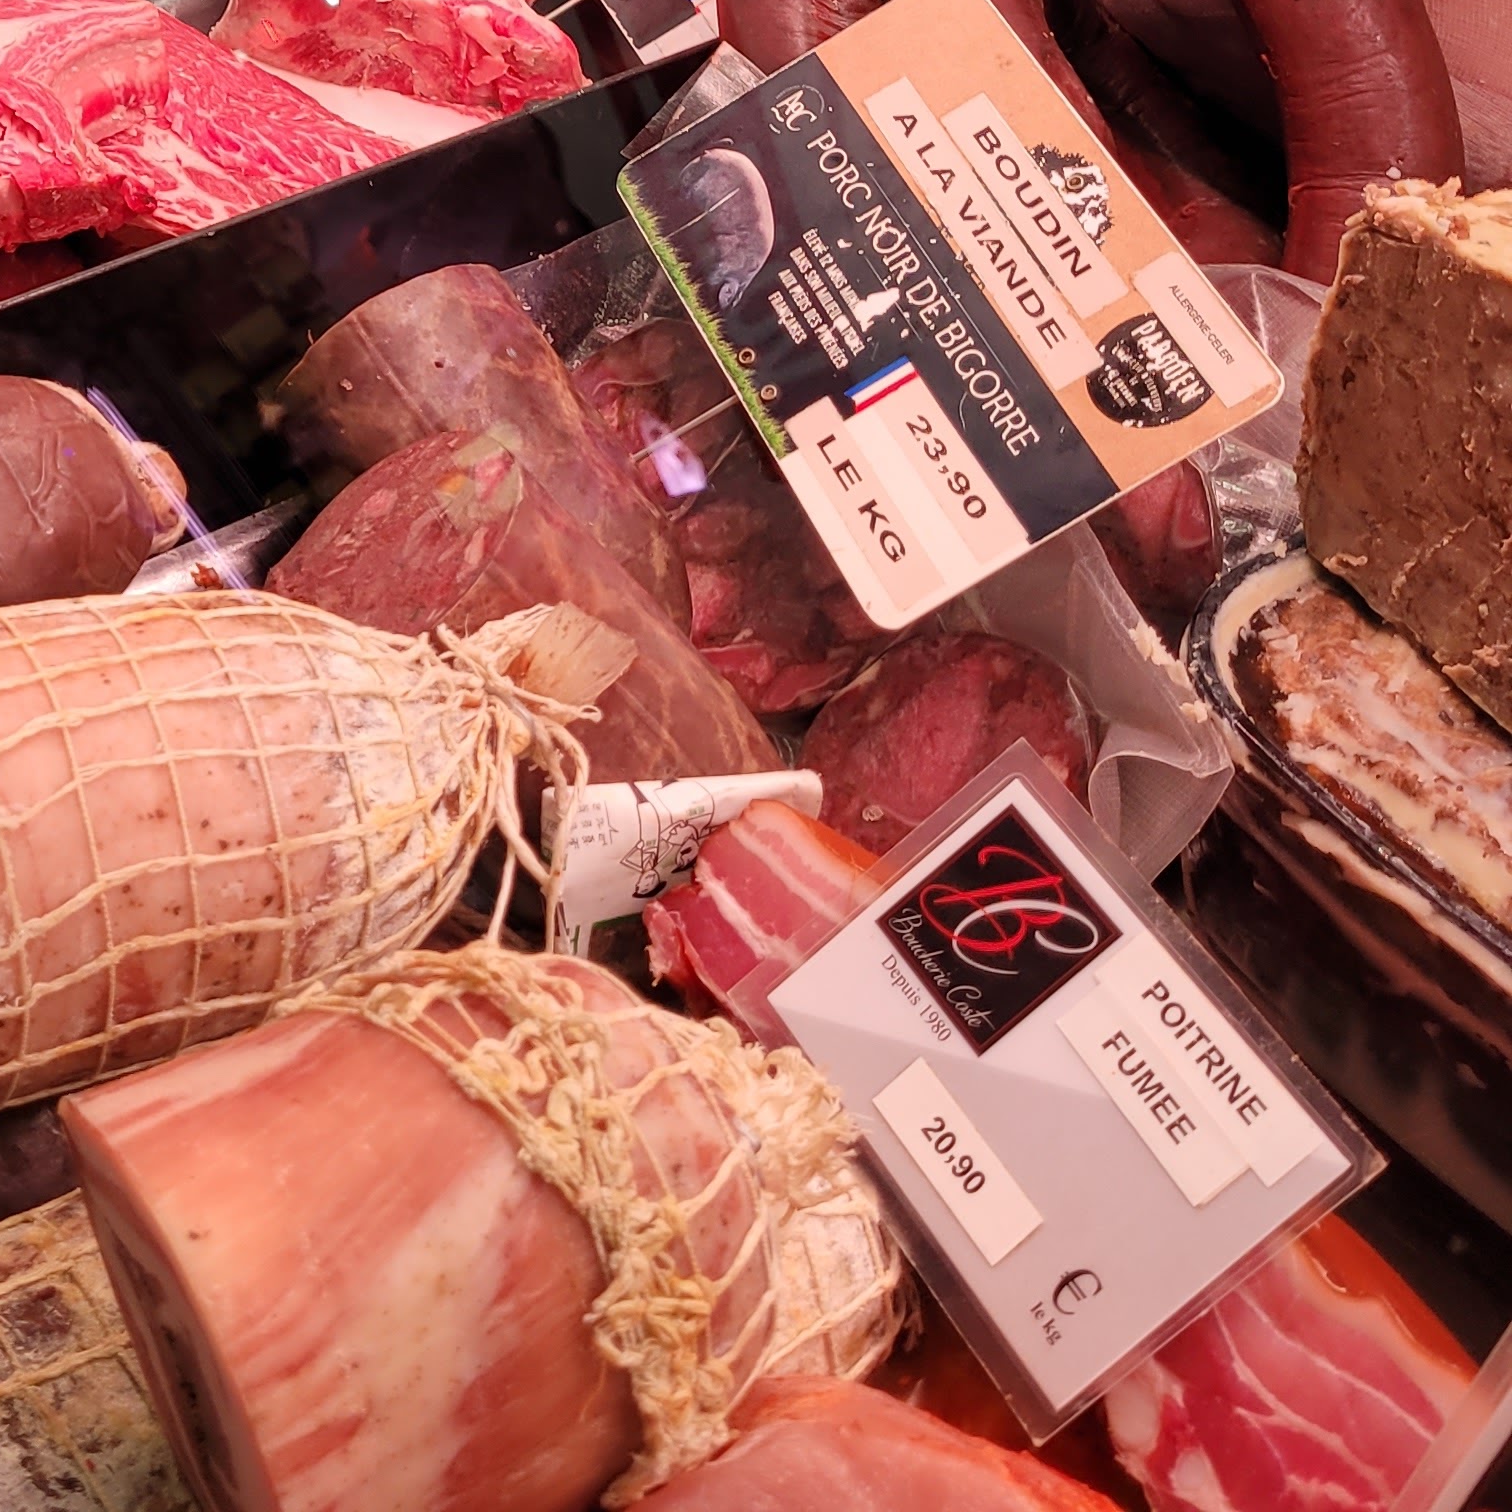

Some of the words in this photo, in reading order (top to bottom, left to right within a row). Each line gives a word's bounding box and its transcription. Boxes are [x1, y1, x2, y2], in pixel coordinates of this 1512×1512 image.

[892, 112, 919, 138] A
[915, 141, 956, 193] LA
[958, 196, 1070, 352] VIANDE
[971, 124, 1094, 282] BOUDIN
[806, 129, 871, 210] PORC
[855, 205, 924, 286] NOIR
[905, 279, 947, 326] DE
[934, 326, 1041, 458] BIGORRE
[816, 433, 855, 492] LE
[857, 500, 908, 565] KG
[905, 414, 988, 522] 23,90
[881, 953, 923, 1007] Depuis
[918, 1004, 952, 1043] 1980
[888, 907, 952, 989] Boucherie
[946, 985, 996, 1031] Coste
[1100, 1030, 1198, 1148] FUMEE
[1140, 979, 1269, 1127] POITRINE
[919, 1116, 987, 1197] 20,90
[1029, 1299, 1048, 1319] le
[1042, 1316, 1062, 1347] kg
[1052, 1268, 1103, 1317] €
